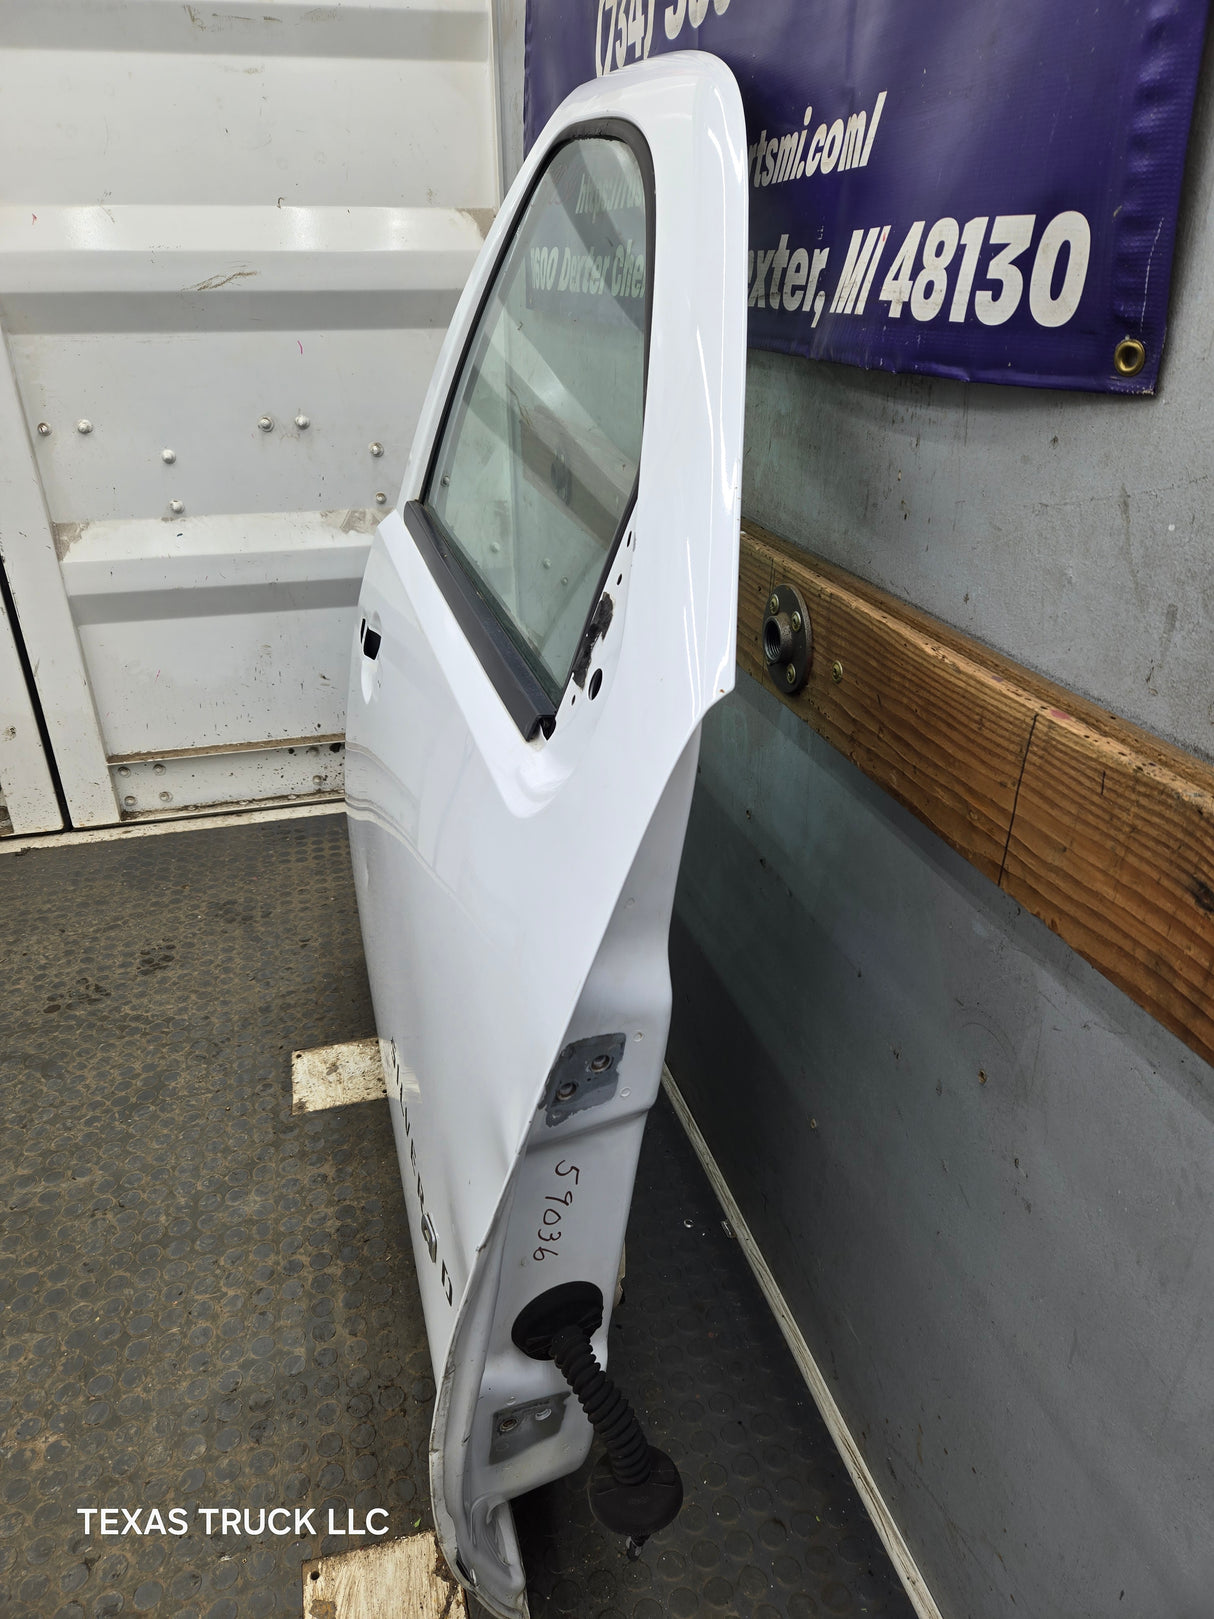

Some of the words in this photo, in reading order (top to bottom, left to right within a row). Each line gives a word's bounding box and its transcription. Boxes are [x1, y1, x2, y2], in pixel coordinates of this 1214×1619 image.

[829, 225, 891, 315] MI
[878, 210, 1091, 328] 48130
[533, 1160, 580, 1261] 59036
